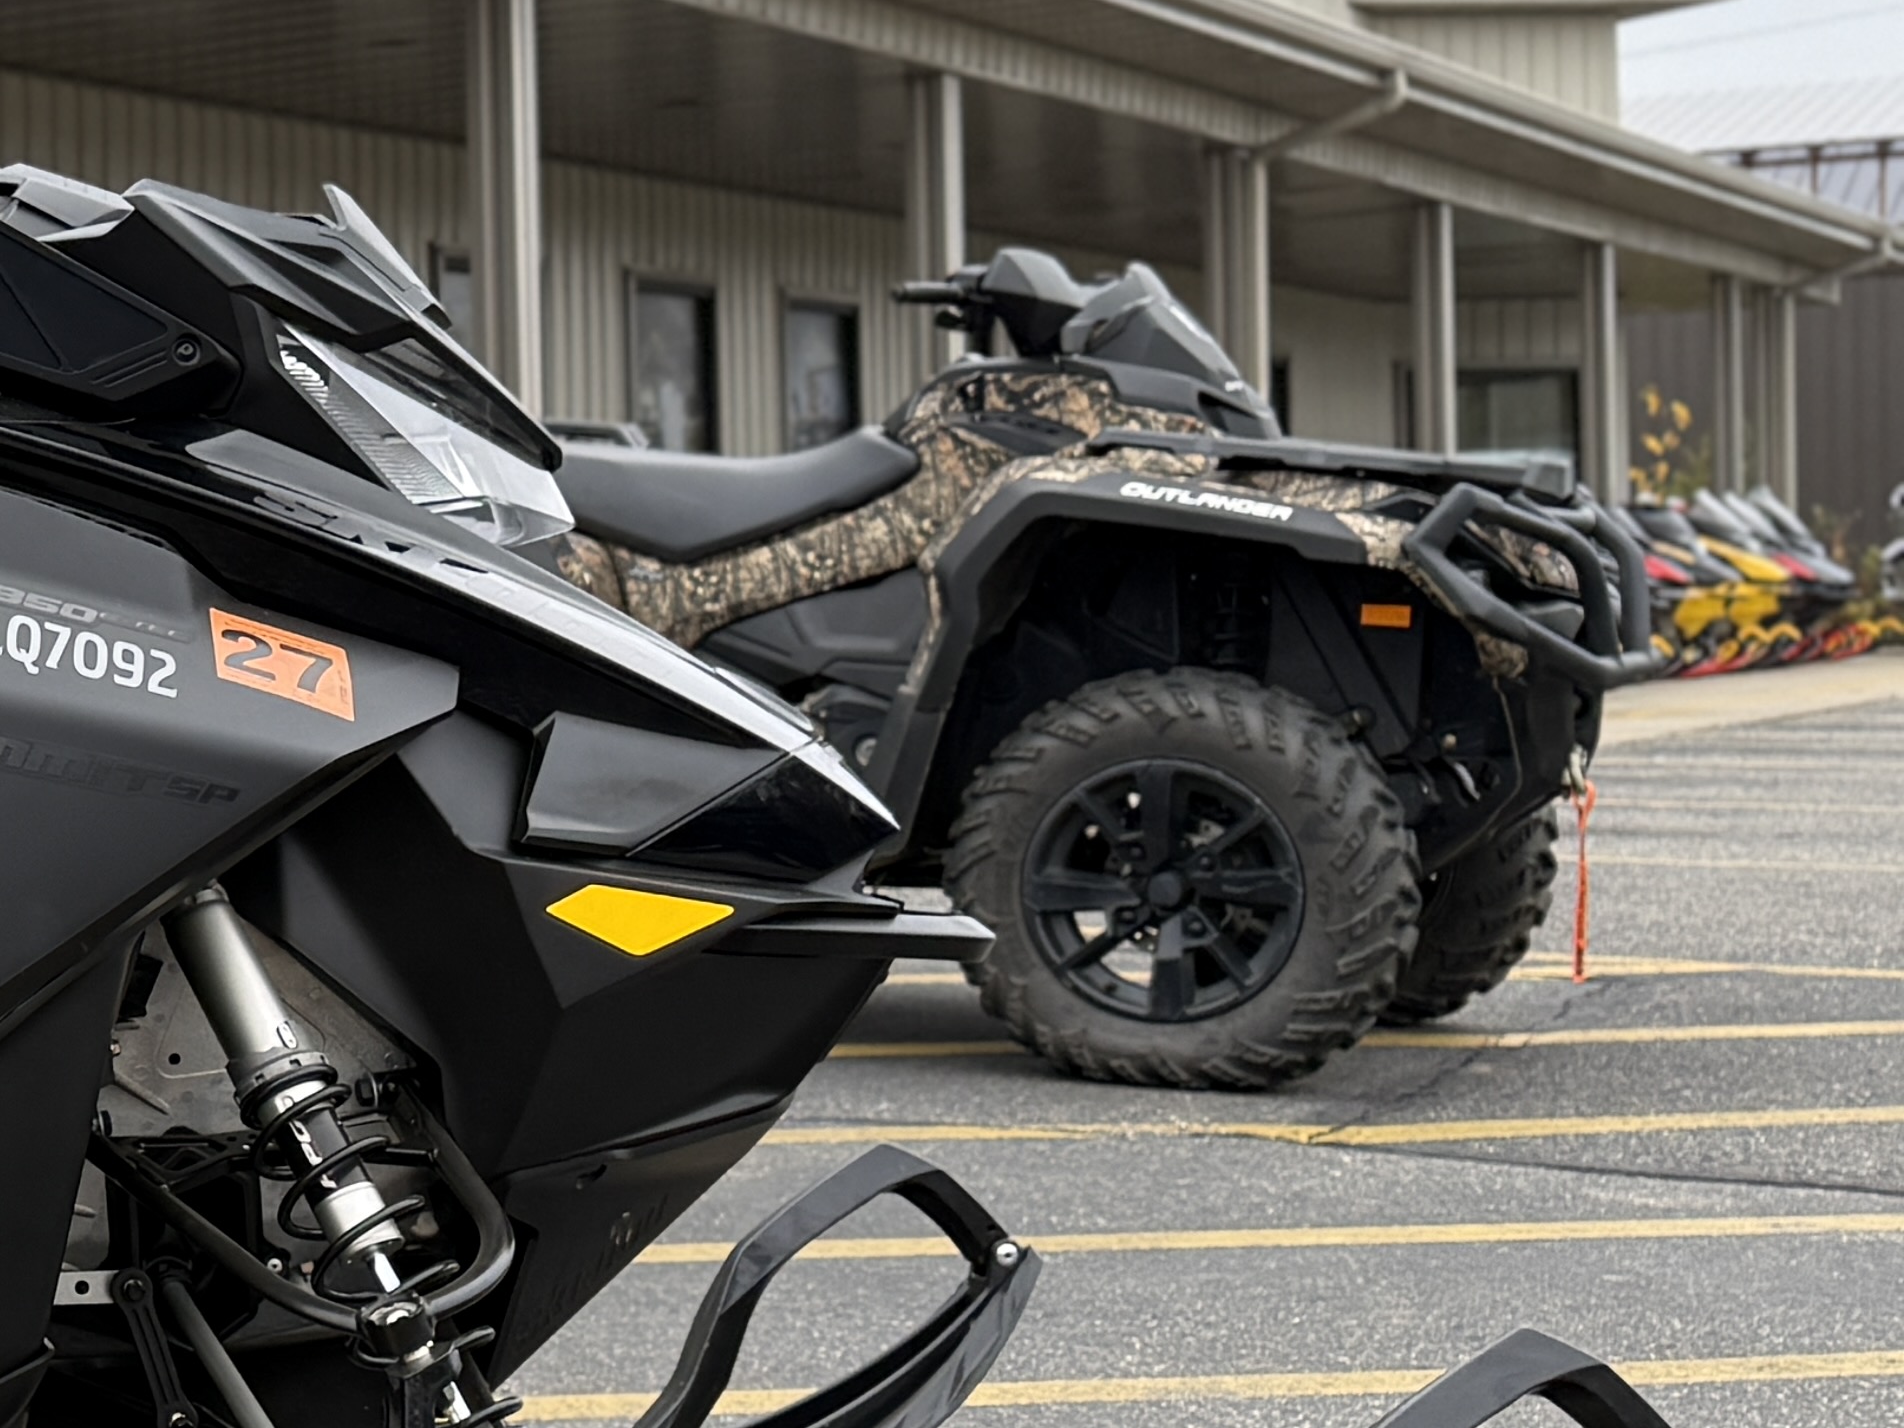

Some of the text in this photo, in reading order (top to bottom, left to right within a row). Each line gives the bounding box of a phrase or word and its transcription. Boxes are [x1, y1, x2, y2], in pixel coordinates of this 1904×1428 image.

[1119, 480, 1294, 522] OUTLANDER
[220, 628, 334, 694] 27
[162, 775, 242, 805] SP
